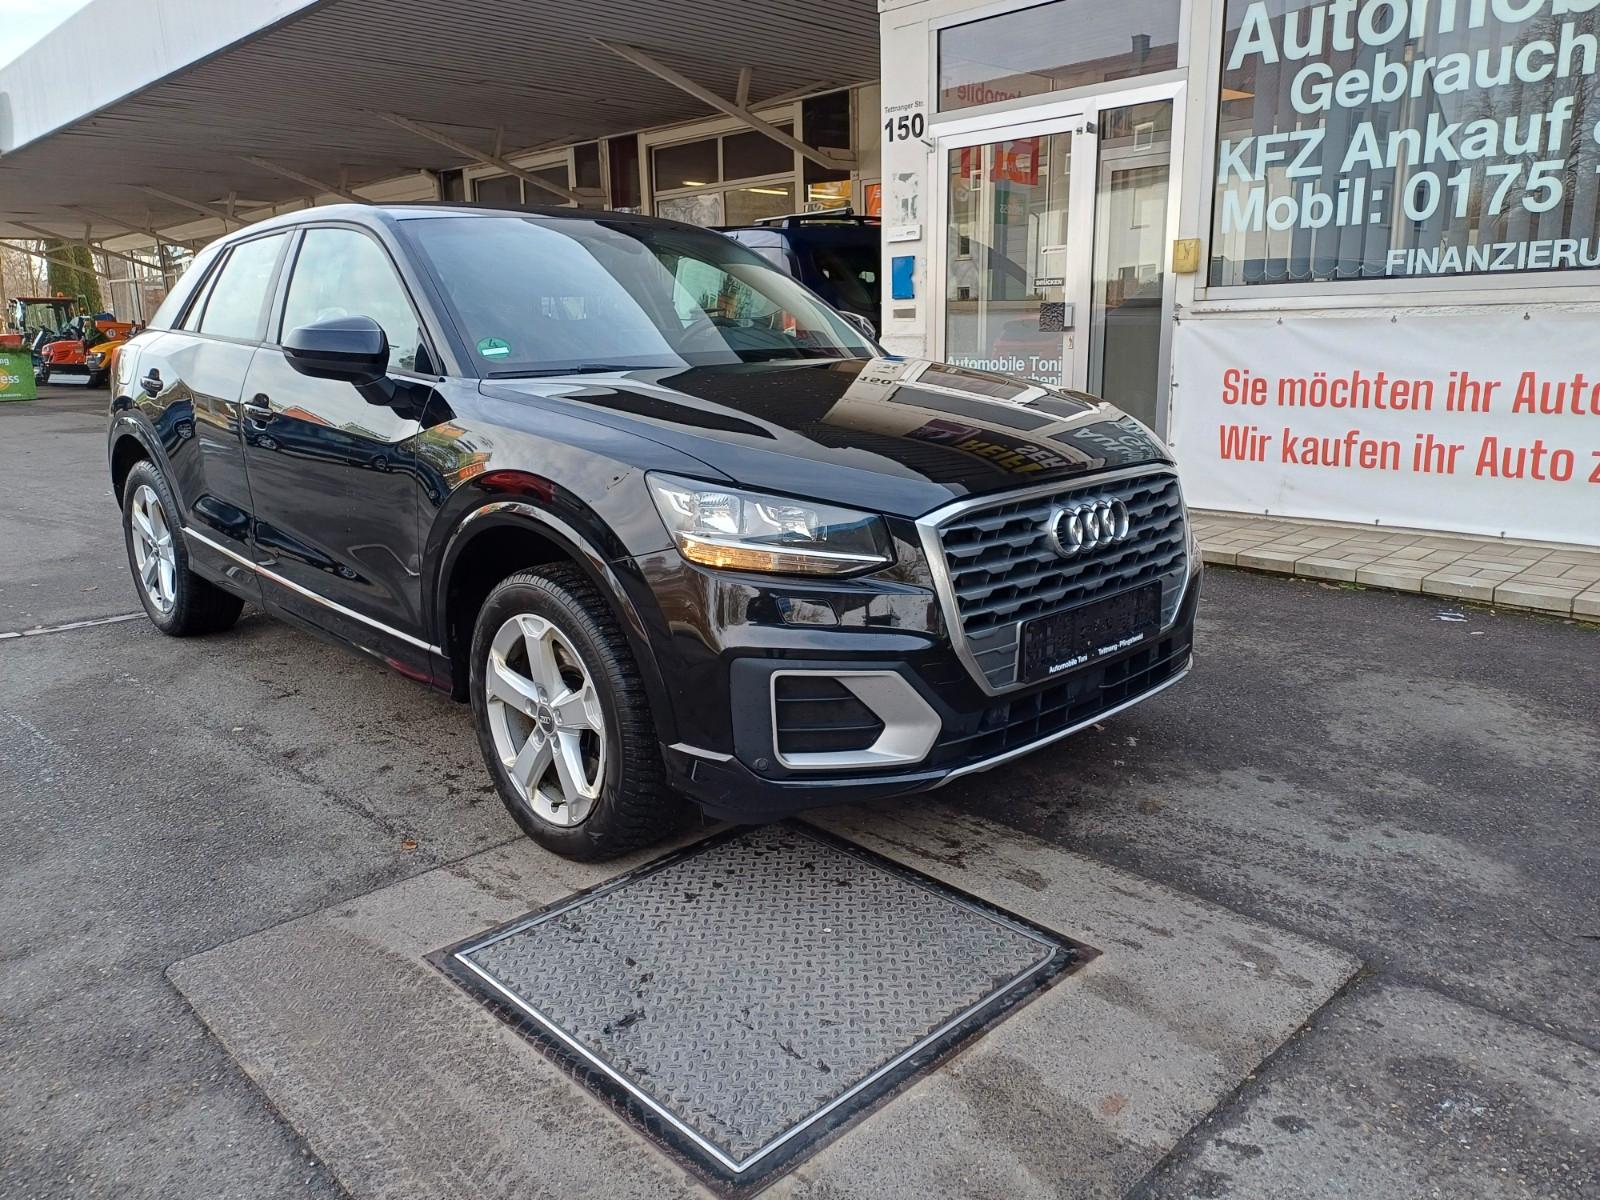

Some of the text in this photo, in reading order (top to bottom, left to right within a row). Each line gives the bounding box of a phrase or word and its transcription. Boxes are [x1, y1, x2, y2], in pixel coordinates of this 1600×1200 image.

[1291, 23, 1598, 114] Gebrauch
[884, 112, 924, 142] 150
[1218, 96, 1575, 185] KFZ Ankauf
[1222, 159, 1566, 234] Mobil: 0175
[1385, 238, 1600, 276] FINANZIERU
[1029, 355, 1063, 372] Toni
[1222, 368, 1268, 406] Sie
[1277, 370, 1434, 411] möchten
[1446, 371, 1501, 413] ihr
[1219, 425, 1272, 462] Wir
[1281, 427, 1401, 471] kaufen
[1412, 433, 1464, 474] ihr
[1475, 436, 1574, 482] Auto
[1049, 658, 1077, 674] Automobile
